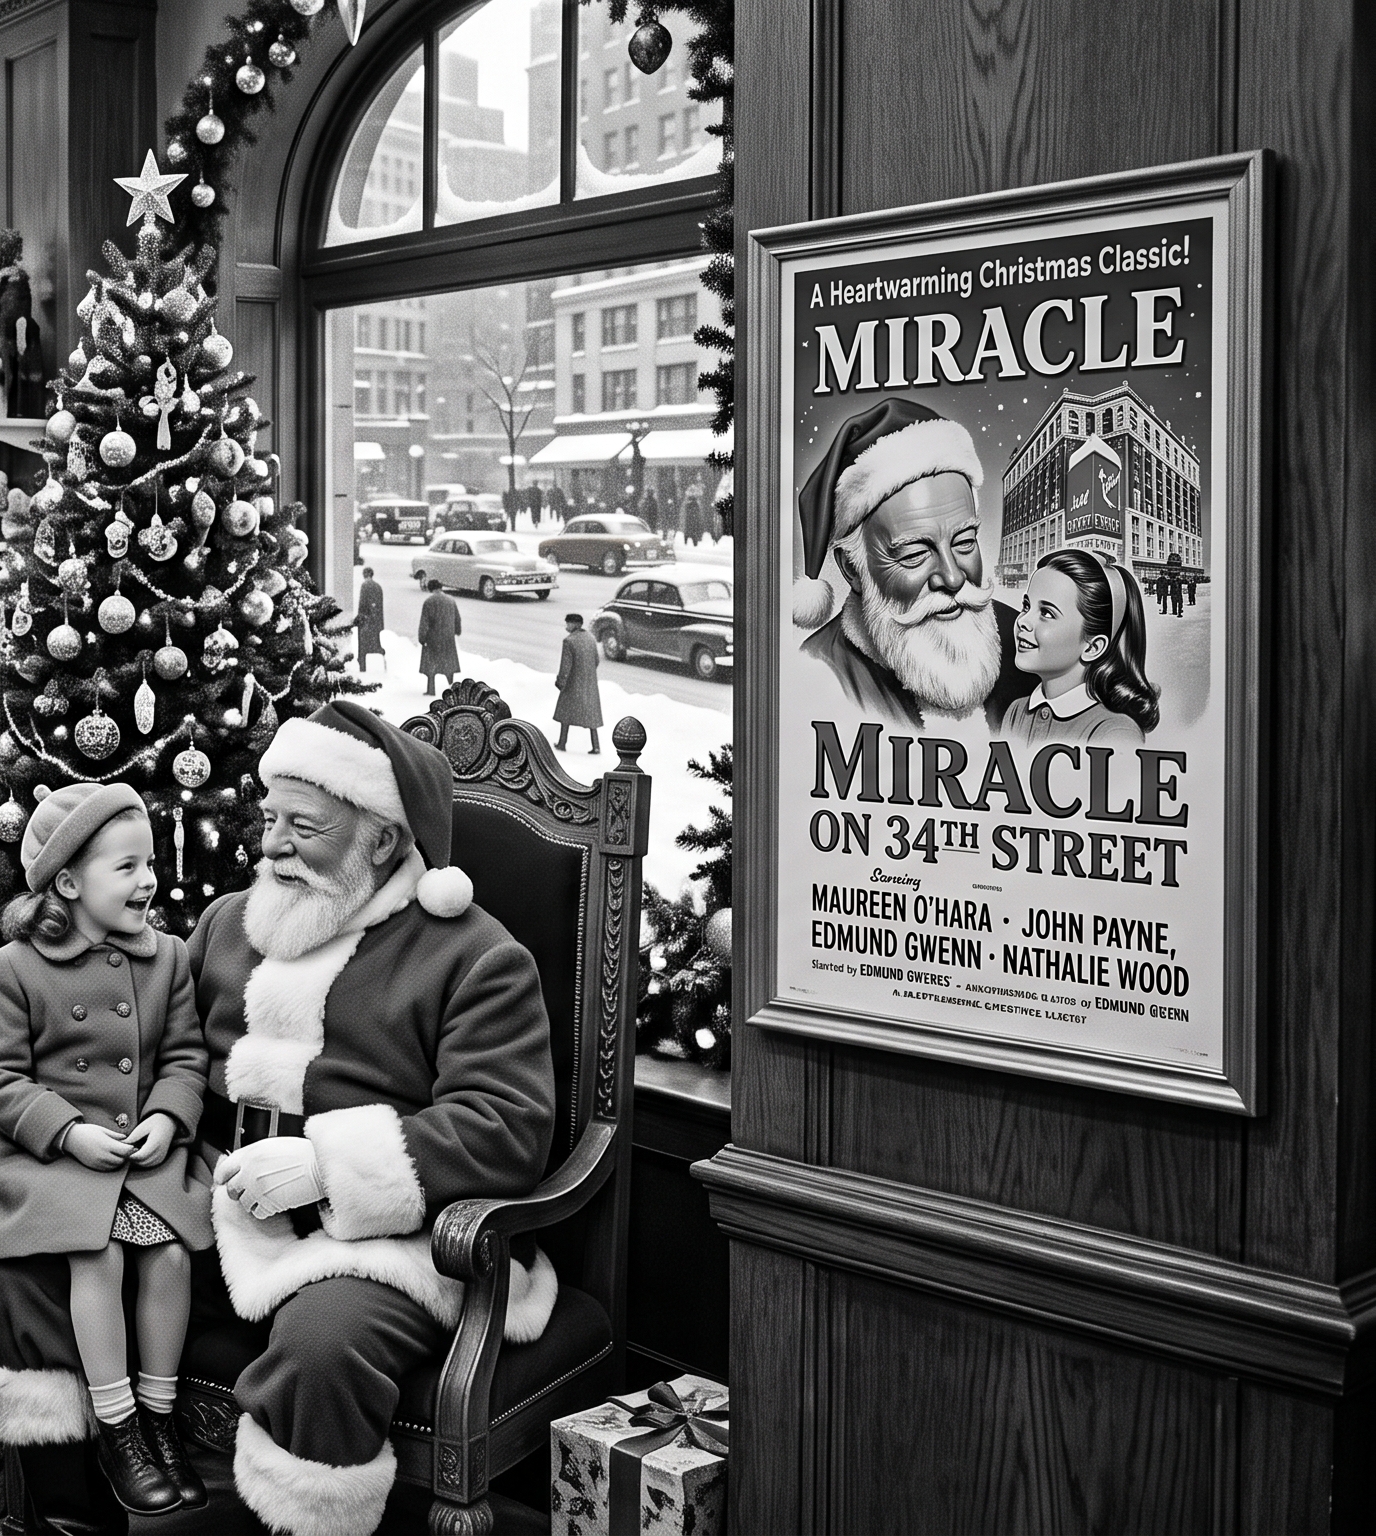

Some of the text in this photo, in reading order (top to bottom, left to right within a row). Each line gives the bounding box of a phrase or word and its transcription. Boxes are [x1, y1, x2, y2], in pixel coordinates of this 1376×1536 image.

[810, 235, 1191, 309] A Heartwarming Christmas Classic!
[814, 287, 1184, 394] MIRACLE
[810, 720, 1189, 828] MIRACLE
[809, 809, 1188, 888] ON 34TH STREET
[812, 883, 1177, 961] MAUREEN O'HARA JOHN PAYNE,
[812, 920, 898, 958] EDMUND
[905, 932, 982, 970] GWENN
[1002, 944, 1110, 988] NATHALIE
[1117, 958, 1190, 997] WOOD
[847, 965, 857, 977] by
[860, 964, 904, 980] EDMUND
[1095, 997, 1145, 1016] EDMUND
